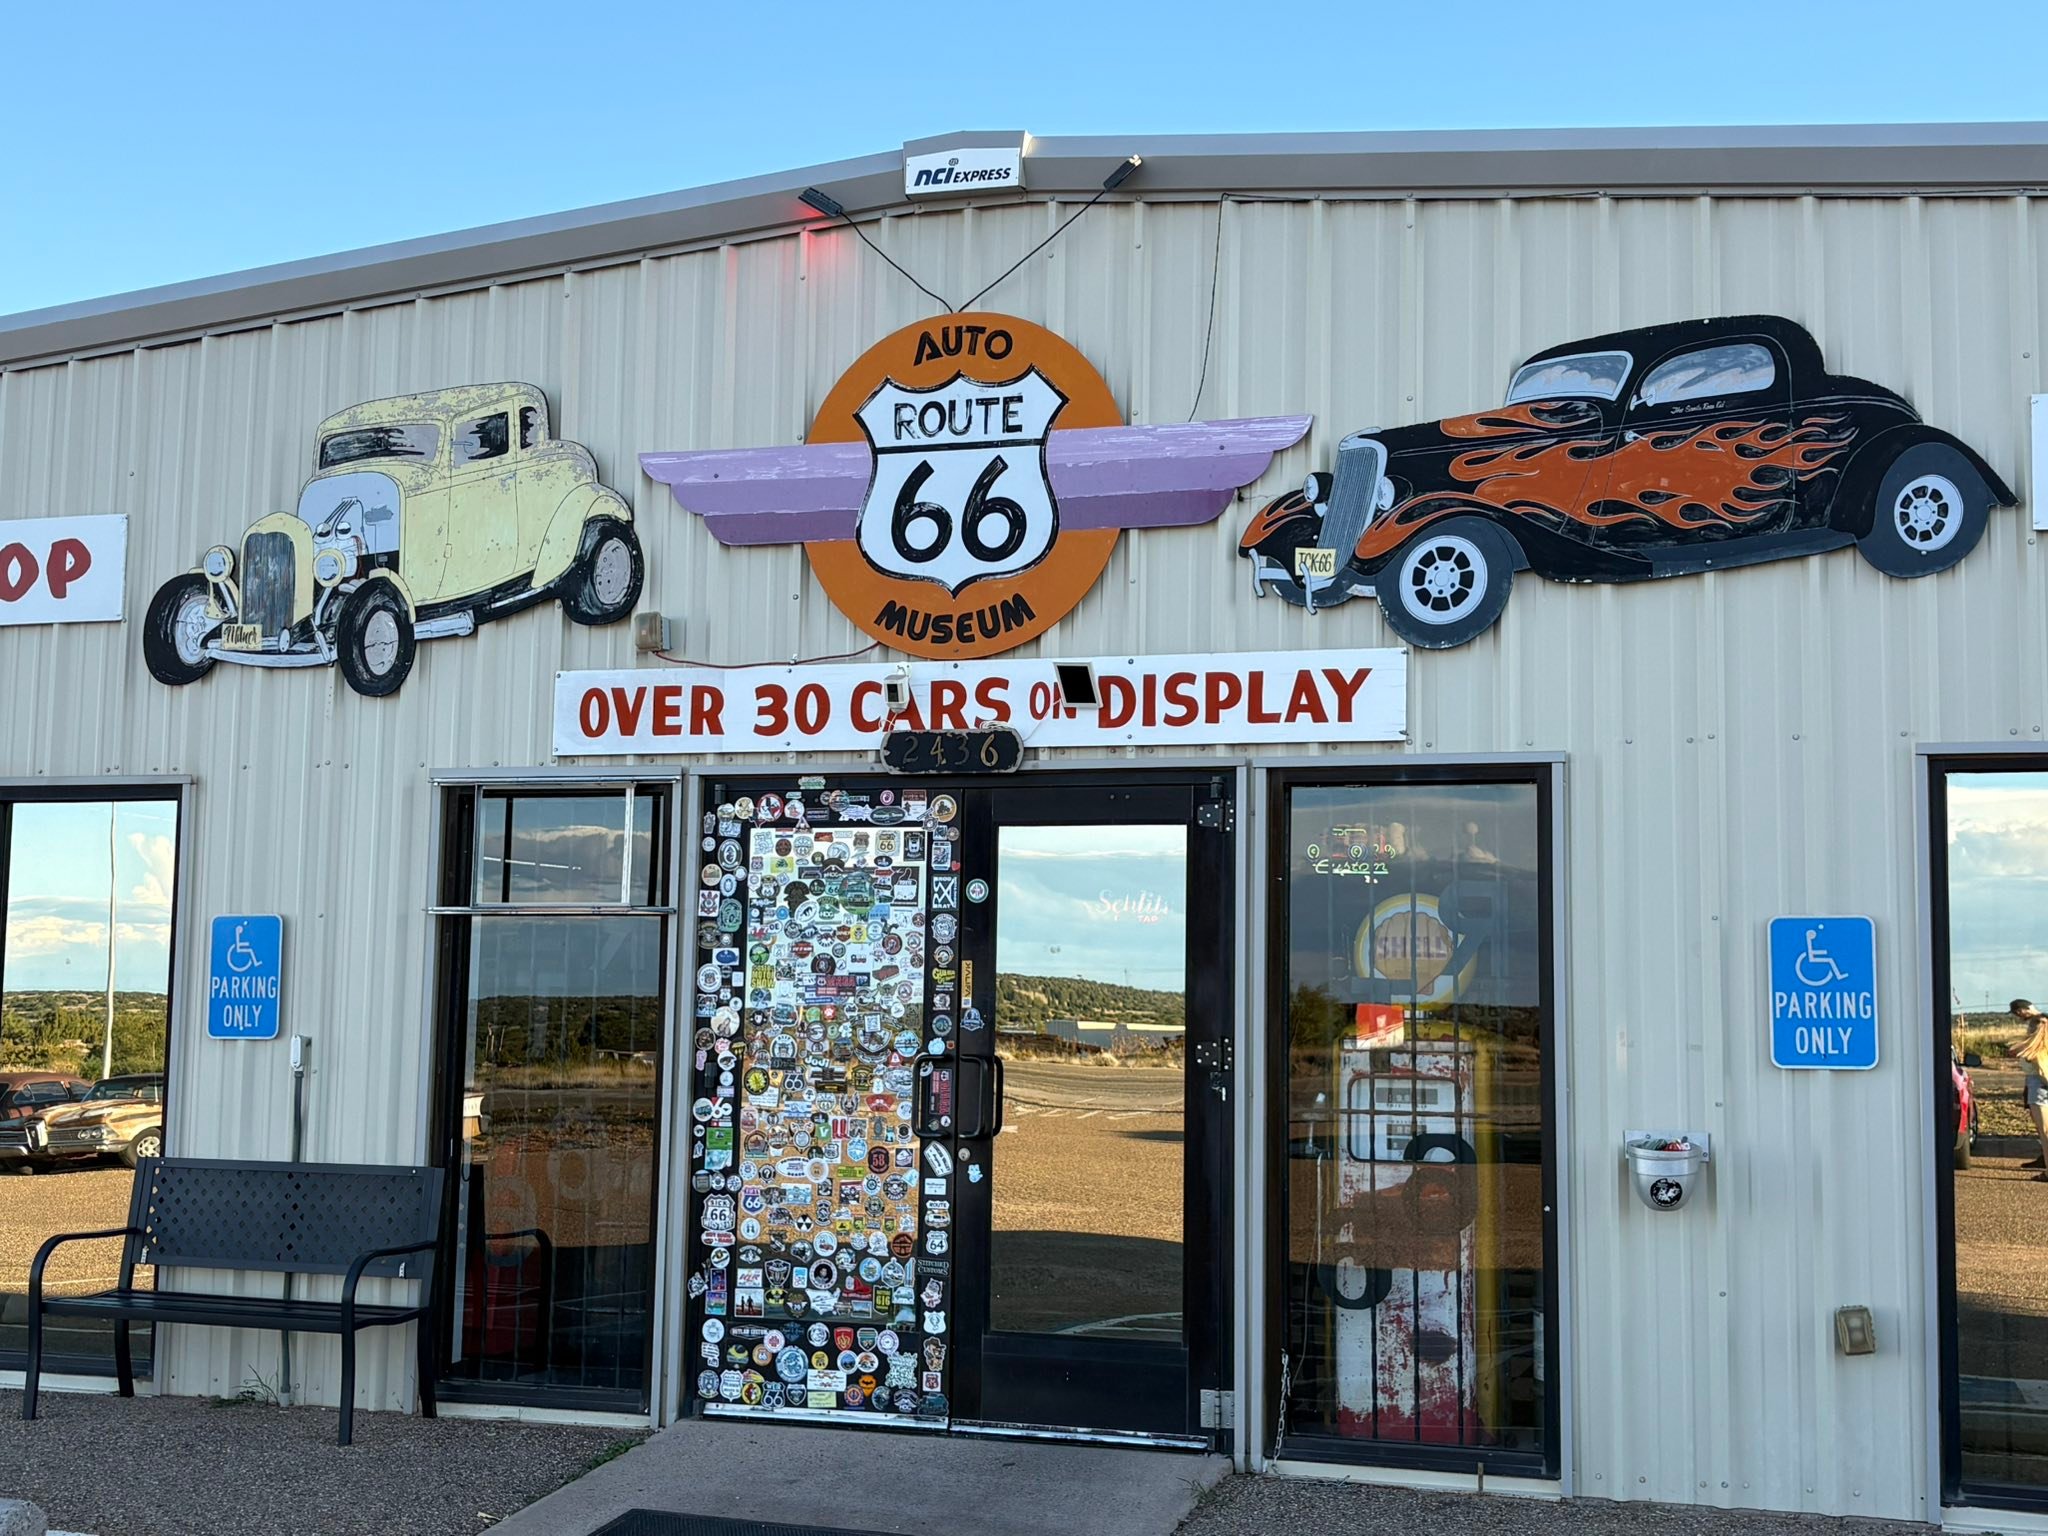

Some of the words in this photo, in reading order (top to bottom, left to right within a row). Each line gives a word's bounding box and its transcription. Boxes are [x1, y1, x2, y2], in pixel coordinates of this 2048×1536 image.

[953, 167, 1011, 183] EXPRESS
[913, 325, 1013, 366] AUTO
[894, 395, 1024, 440] ROUTE
[891, 454, 1027, 564] 66
[874, 593, 1036, 644] MUSEUM
[579, 685, 725, 738] OVER
[753, 683, 831, 737] 30
[1098, 668, 1372, 728] DISPLAY
[903, 734, 999, 767] 2436
[211, 976, 277, 998] PARKING
[223, 1005, 262, 1027] ONLY
[1775, 992, 1872, 1019] PARKING
[1795, 1027, 1852, 1054] ONLY
[711, 1208, 726, 1219] 66
[930, 1240, 944, 1250] 64
